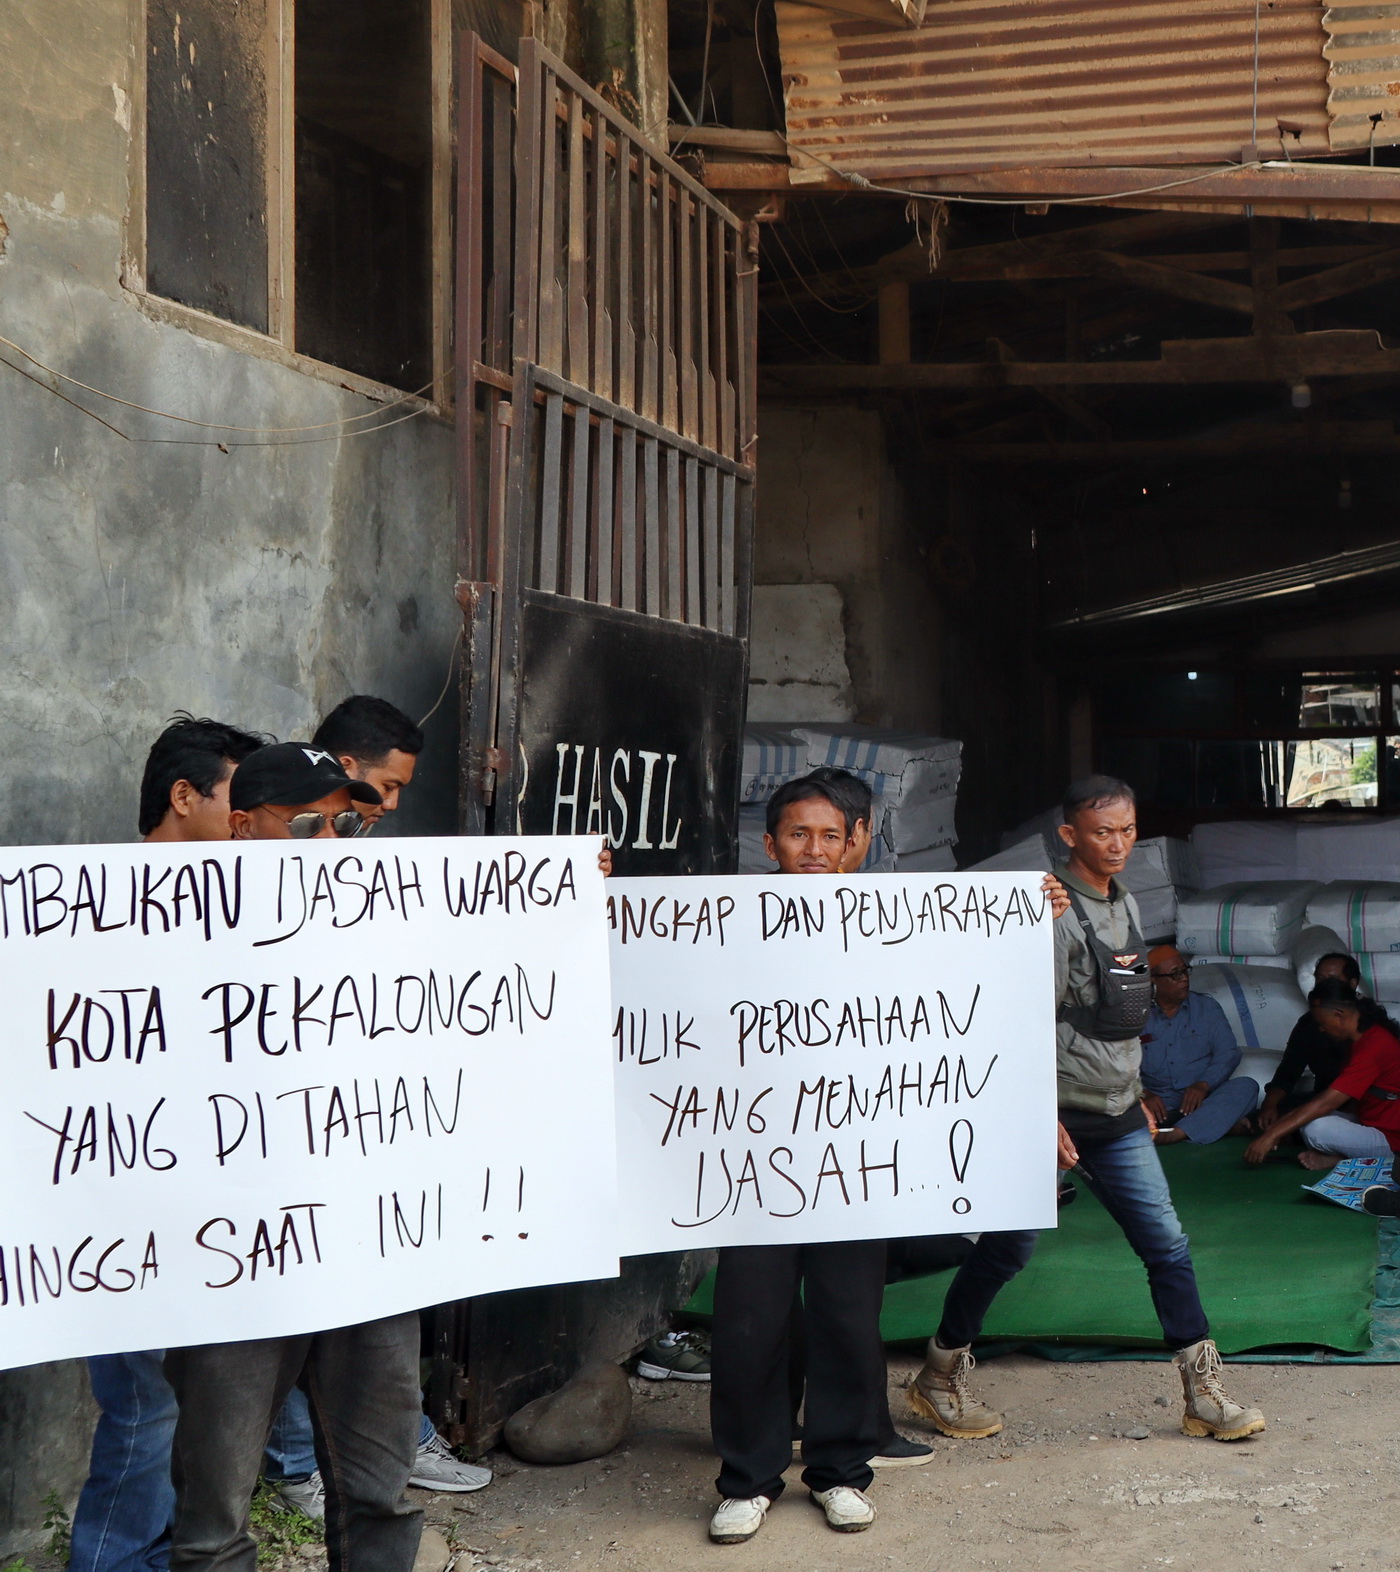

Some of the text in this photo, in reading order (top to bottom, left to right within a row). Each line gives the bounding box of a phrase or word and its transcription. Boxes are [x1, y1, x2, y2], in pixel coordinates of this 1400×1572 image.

[553, 742, 682, 850] HASIL
[0, 850, 577, 948] MBALIKAN IJASAH WARGA
[757, 890, 825, 942] DAN
[840, 884, 1047, 952] PENJARAKAN
[47, 962, 556, 1069] KOTA PEKALONGAN
[730, 984, 980, 1067] PERUSAHAAN
[23, 1097, 177, 1184] YANG
[648, 1055, 998, 1148] YANG MENAHAN
[195, 1203, 326, 1288] SAAT
[378, 1182, 442, 1259] INI
